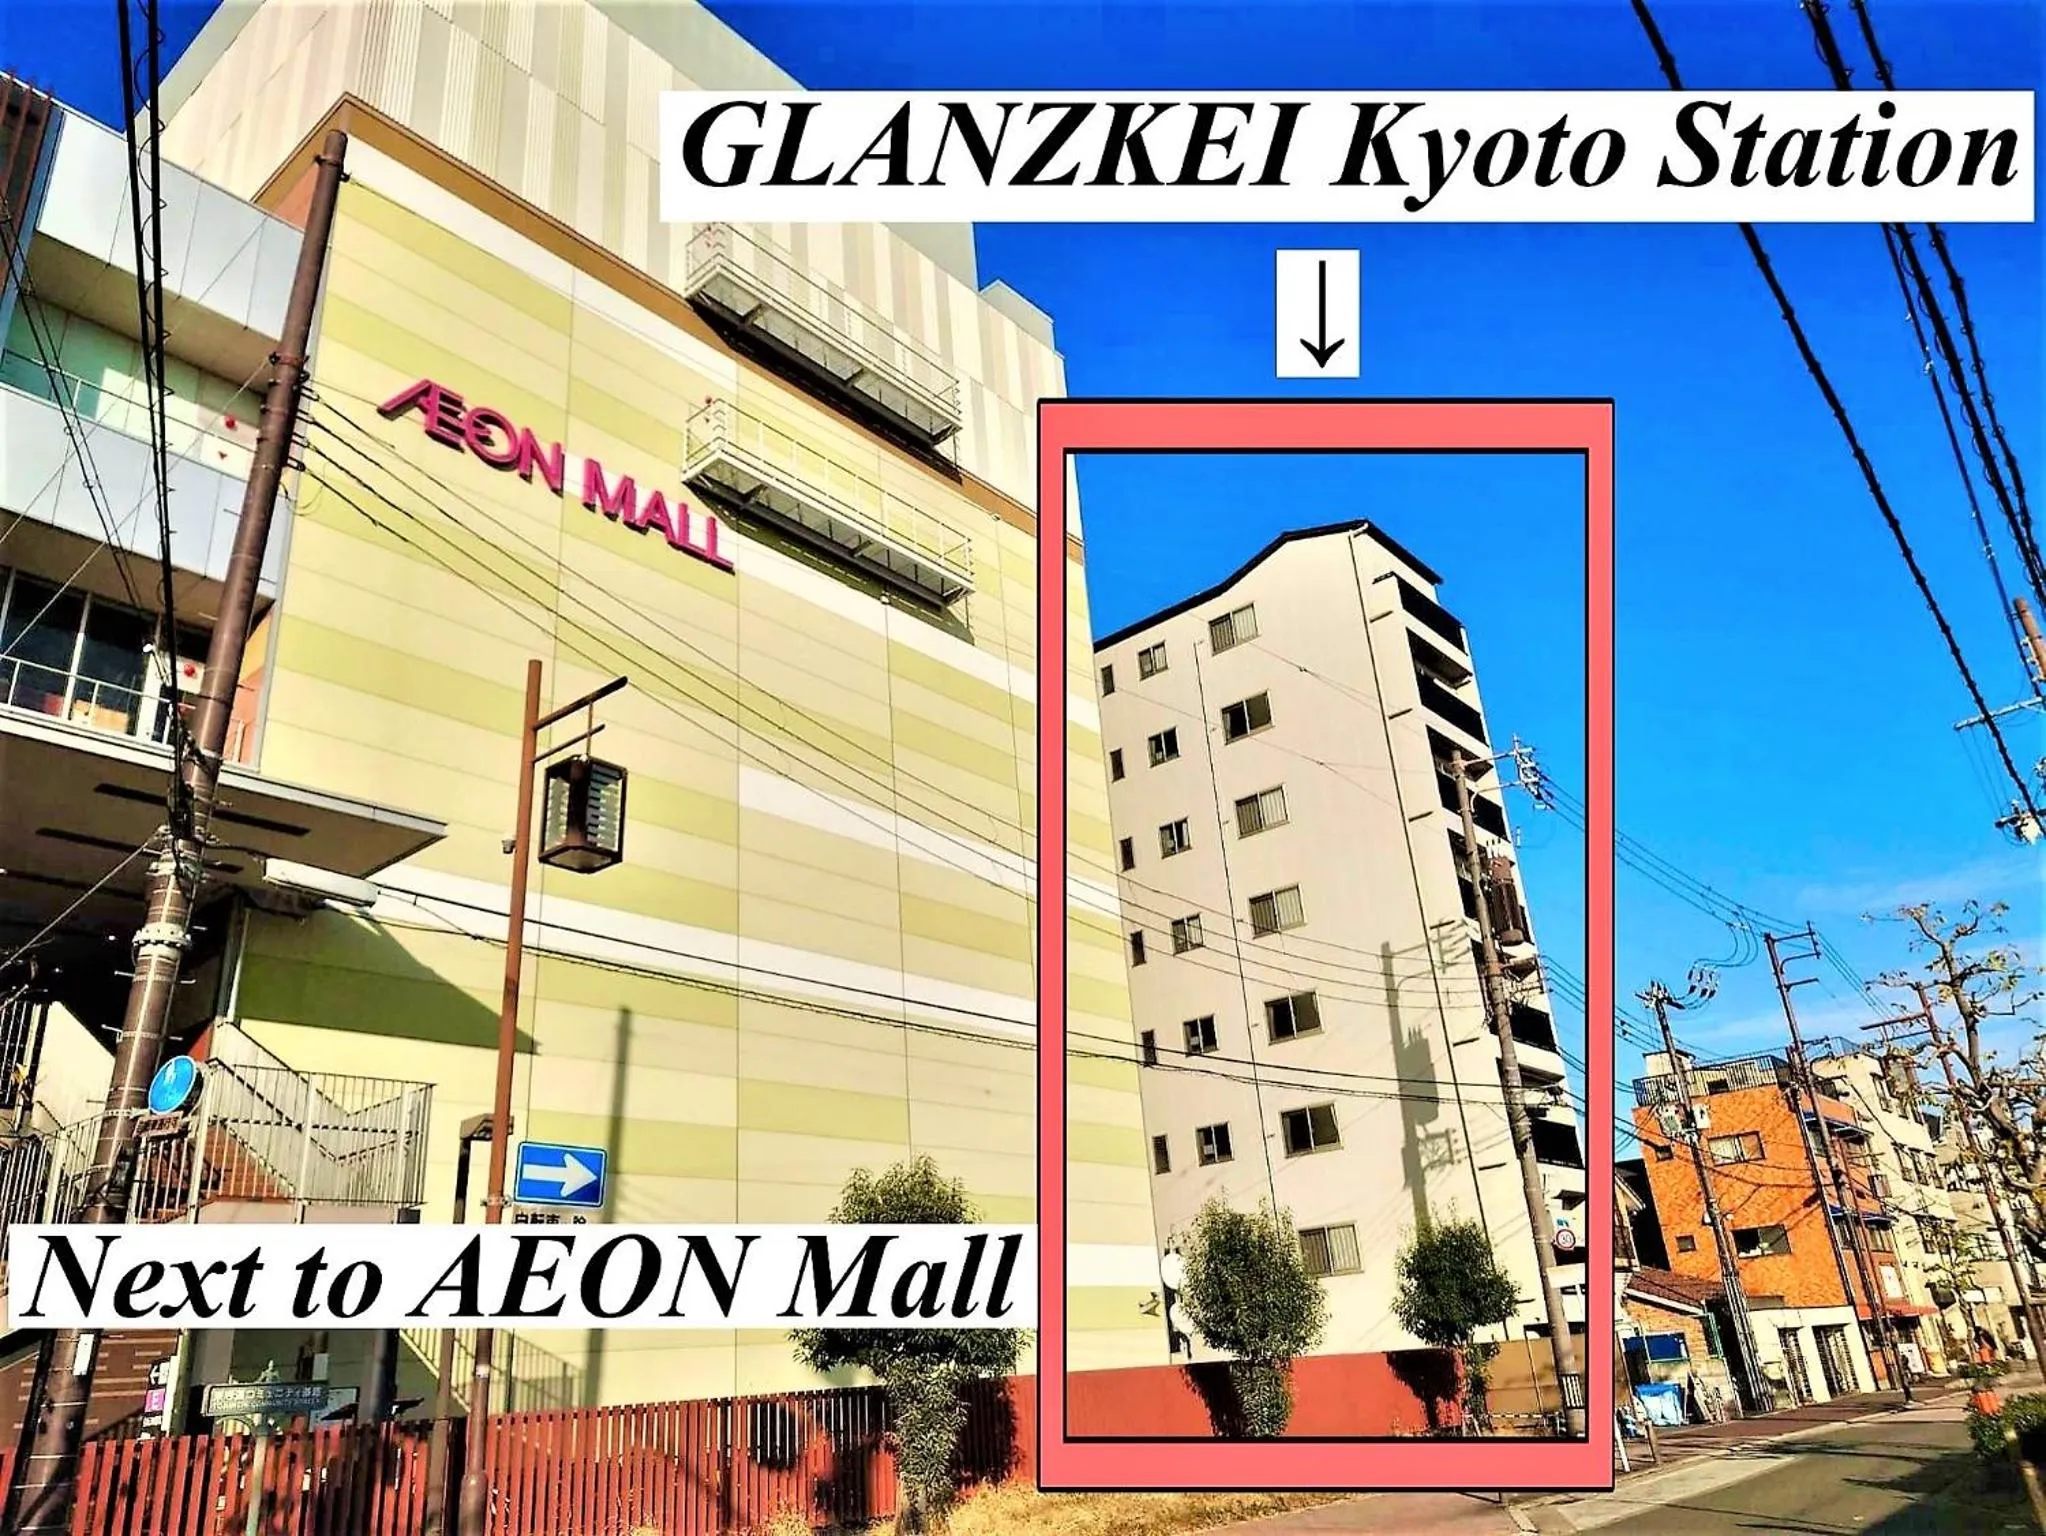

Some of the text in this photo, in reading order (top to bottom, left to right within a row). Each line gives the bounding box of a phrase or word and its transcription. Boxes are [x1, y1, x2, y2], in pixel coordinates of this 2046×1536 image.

[377, 379, 735, 574] AEON MALL
[1559, 1233, 1572, 1244] 30
